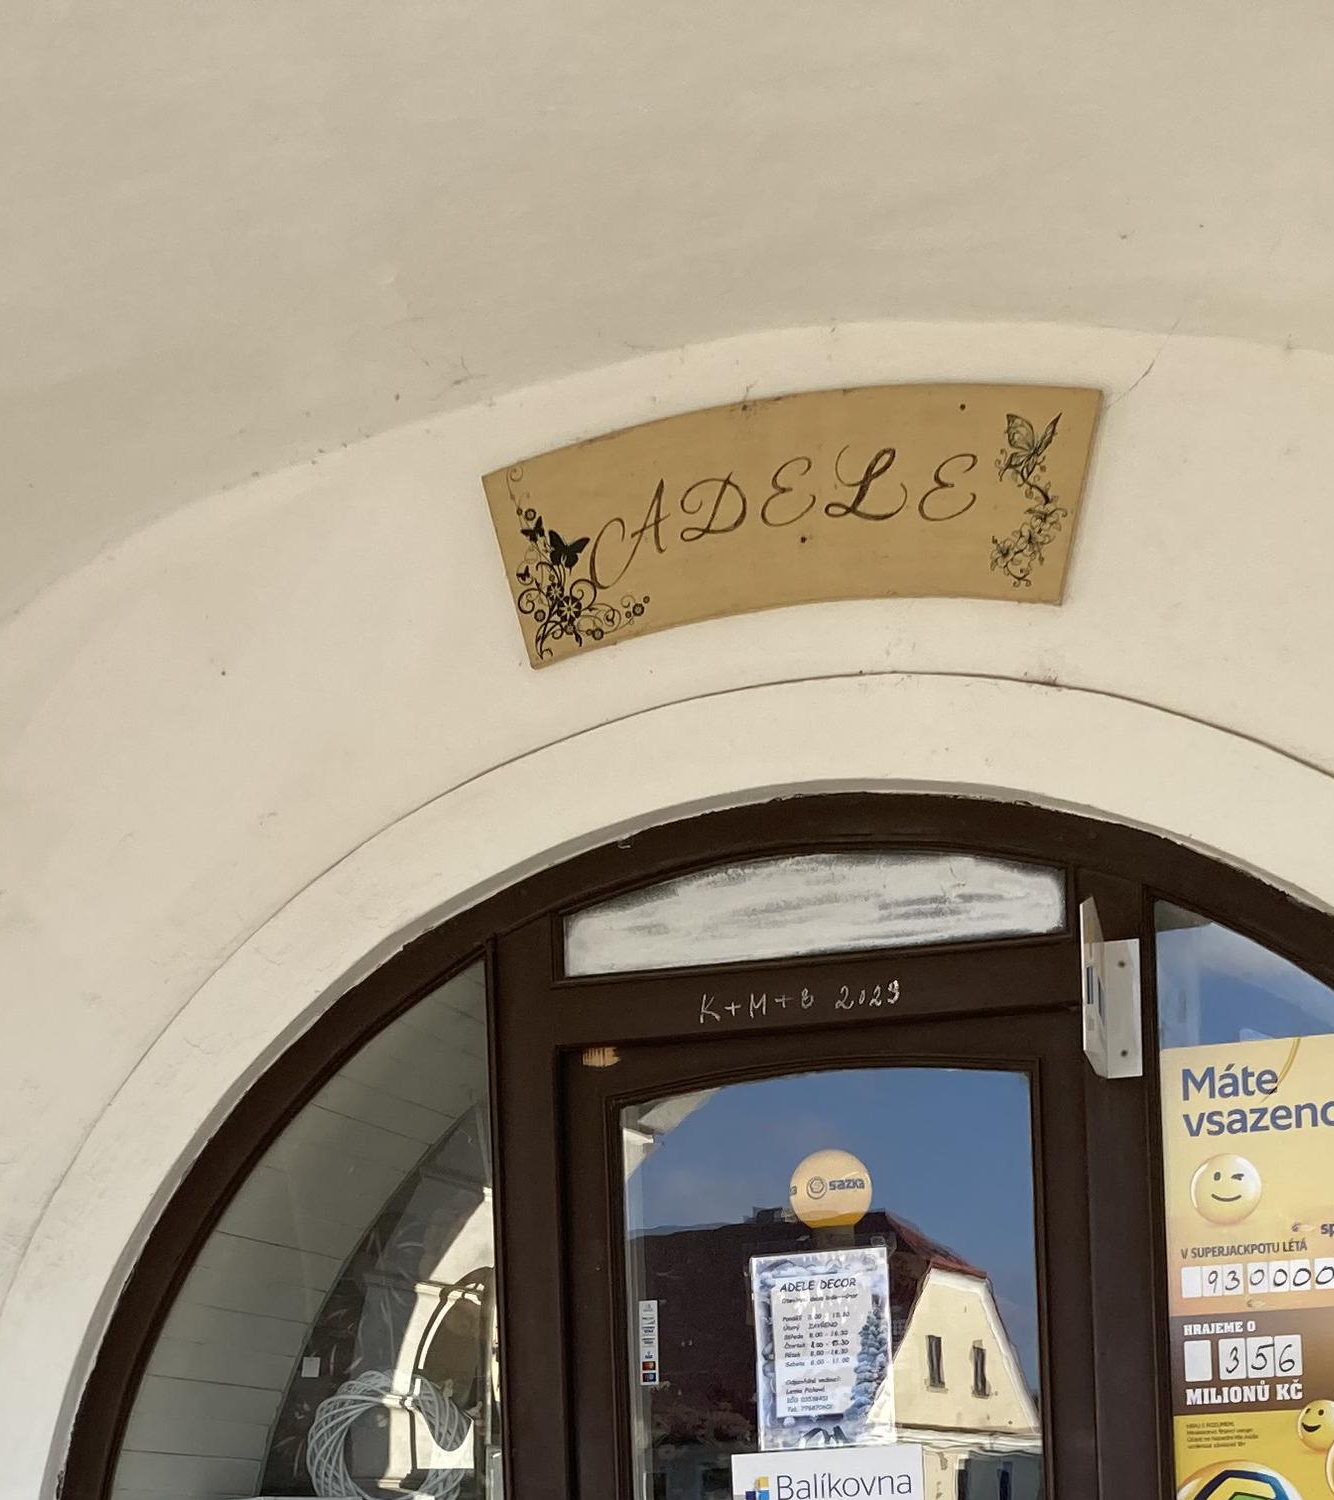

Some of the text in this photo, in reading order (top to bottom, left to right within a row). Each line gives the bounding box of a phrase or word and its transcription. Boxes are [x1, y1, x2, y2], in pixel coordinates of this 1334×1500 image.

[589, 444, 978, 590] ADELE
[1182, 1063, 1278, 1101] Máte
[829, 1178, 865, 1191] sazka
[1181, 1237, 1308, 1260] V SUPERJACKPOTU LÉTÁ
[780, 1277, 857, 1293] ADELE DECOR
[1183, 1320, 1256, 1336] HRAJEME O
[1225, 1343, 1296, 1374] 356
[1186, 1378, 1303, 1405] MILIONŮ KČ
[777, 1473, 912, 1500] Balíkovna
